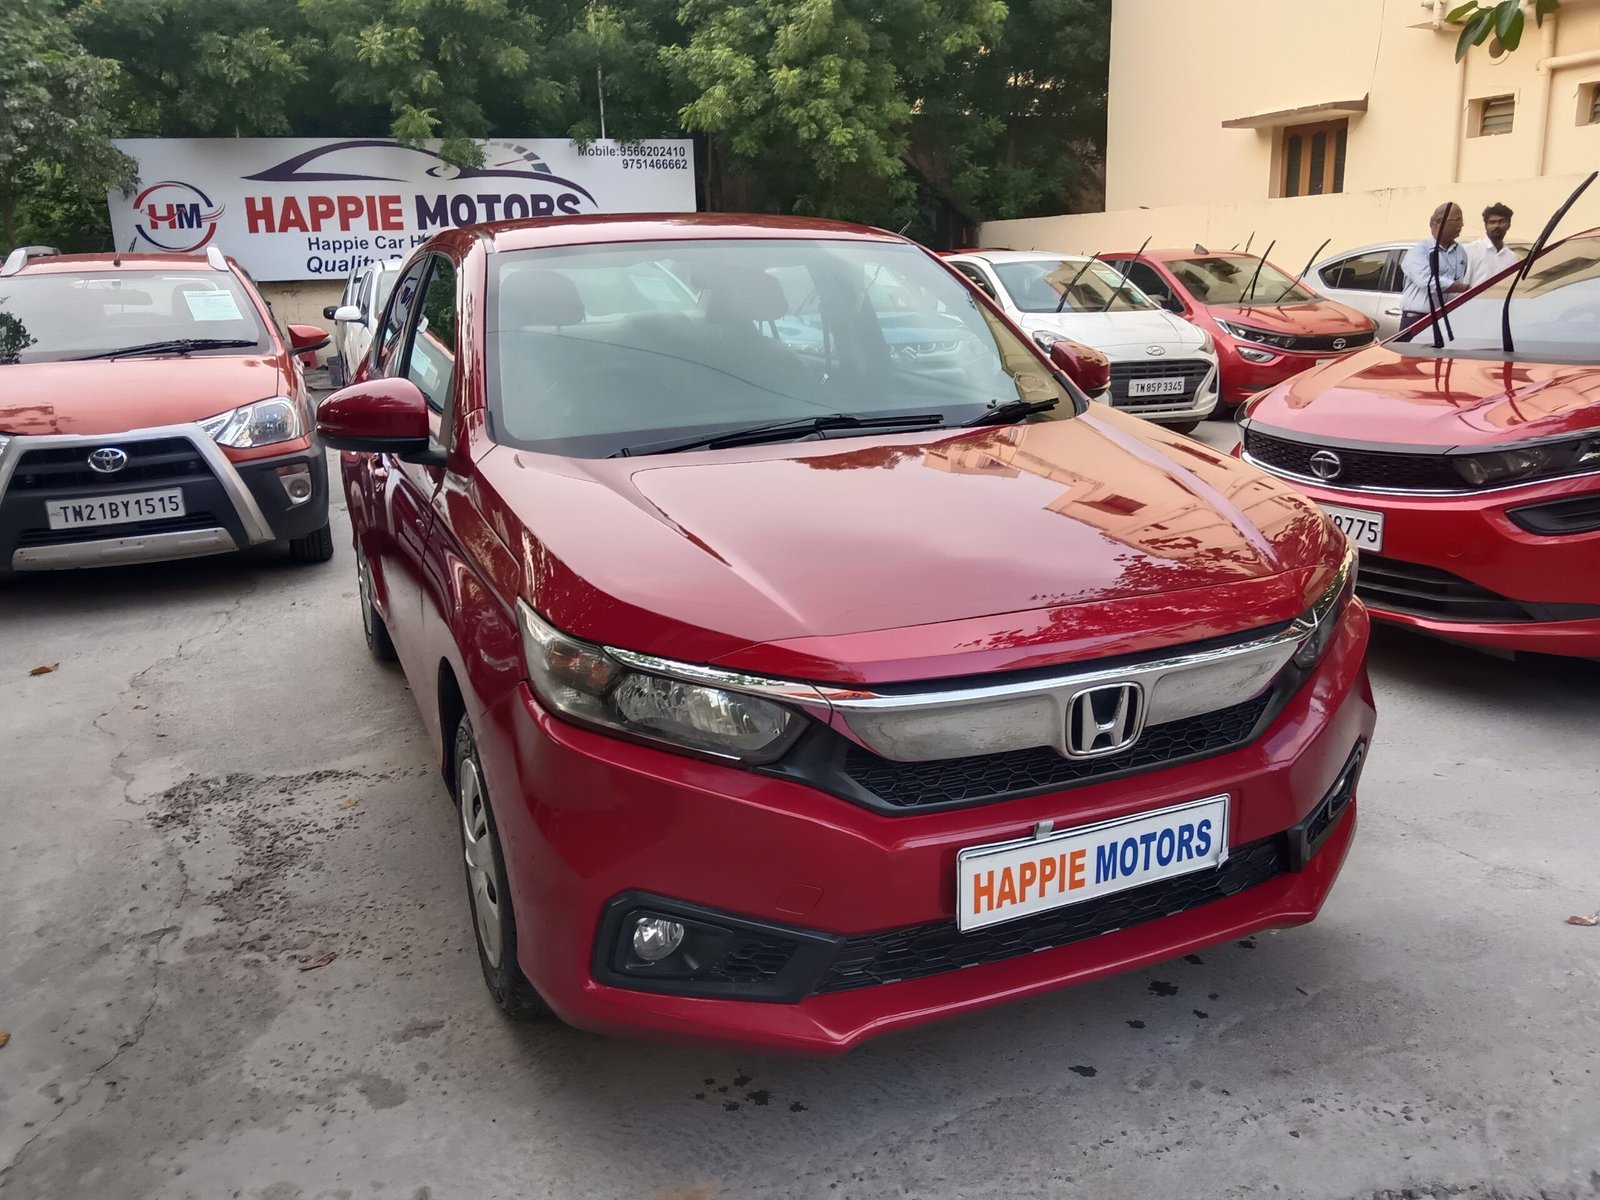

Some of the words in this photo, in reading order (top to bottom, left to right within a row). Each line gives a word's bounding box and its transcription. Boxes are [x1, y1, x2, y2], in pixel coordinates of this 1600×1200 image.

[622, 158, 688, 170] 9751466662
[147, 203, 203, 230] HM
[245, 195, 404, 233] HAPPIE
[415, 193, 581, 230] MOTORS
[307, 235, 370, 254] Happie
[374, 235, 405, 250] Car
[306, 254, 383, 274] Qualit
[59, 495, 180, 524] TN21BY1515
[1328, 513, 1379, 544] 775
[973, 848, 1087, 916] HAPPIE
[1094, 818, 1212, 885] MOTORS
